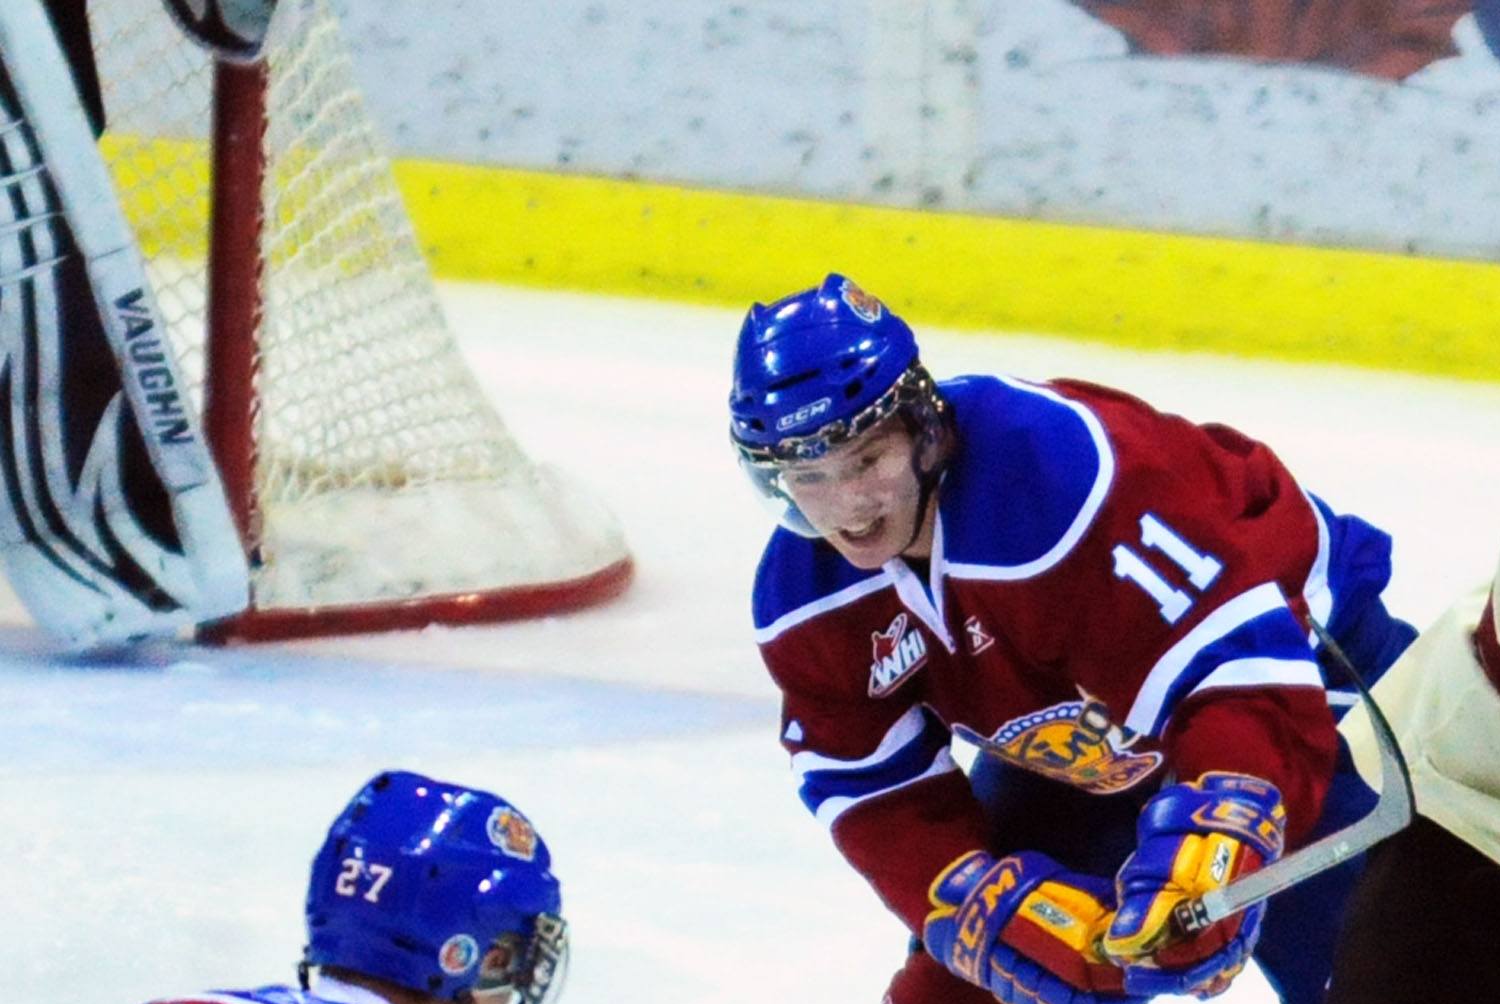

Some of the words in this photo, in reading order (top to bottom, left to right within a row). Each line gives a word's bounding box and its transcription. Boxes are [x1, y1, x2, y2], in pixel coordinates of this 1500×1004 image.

[115, 287, 195, 445] VAUGHN
[779, 400, 829, 429] CCM
[1110, 511, 1226, 626] 11
[335, 858, 393, 903] 27
[952, 867, 1017, 977] CCM
